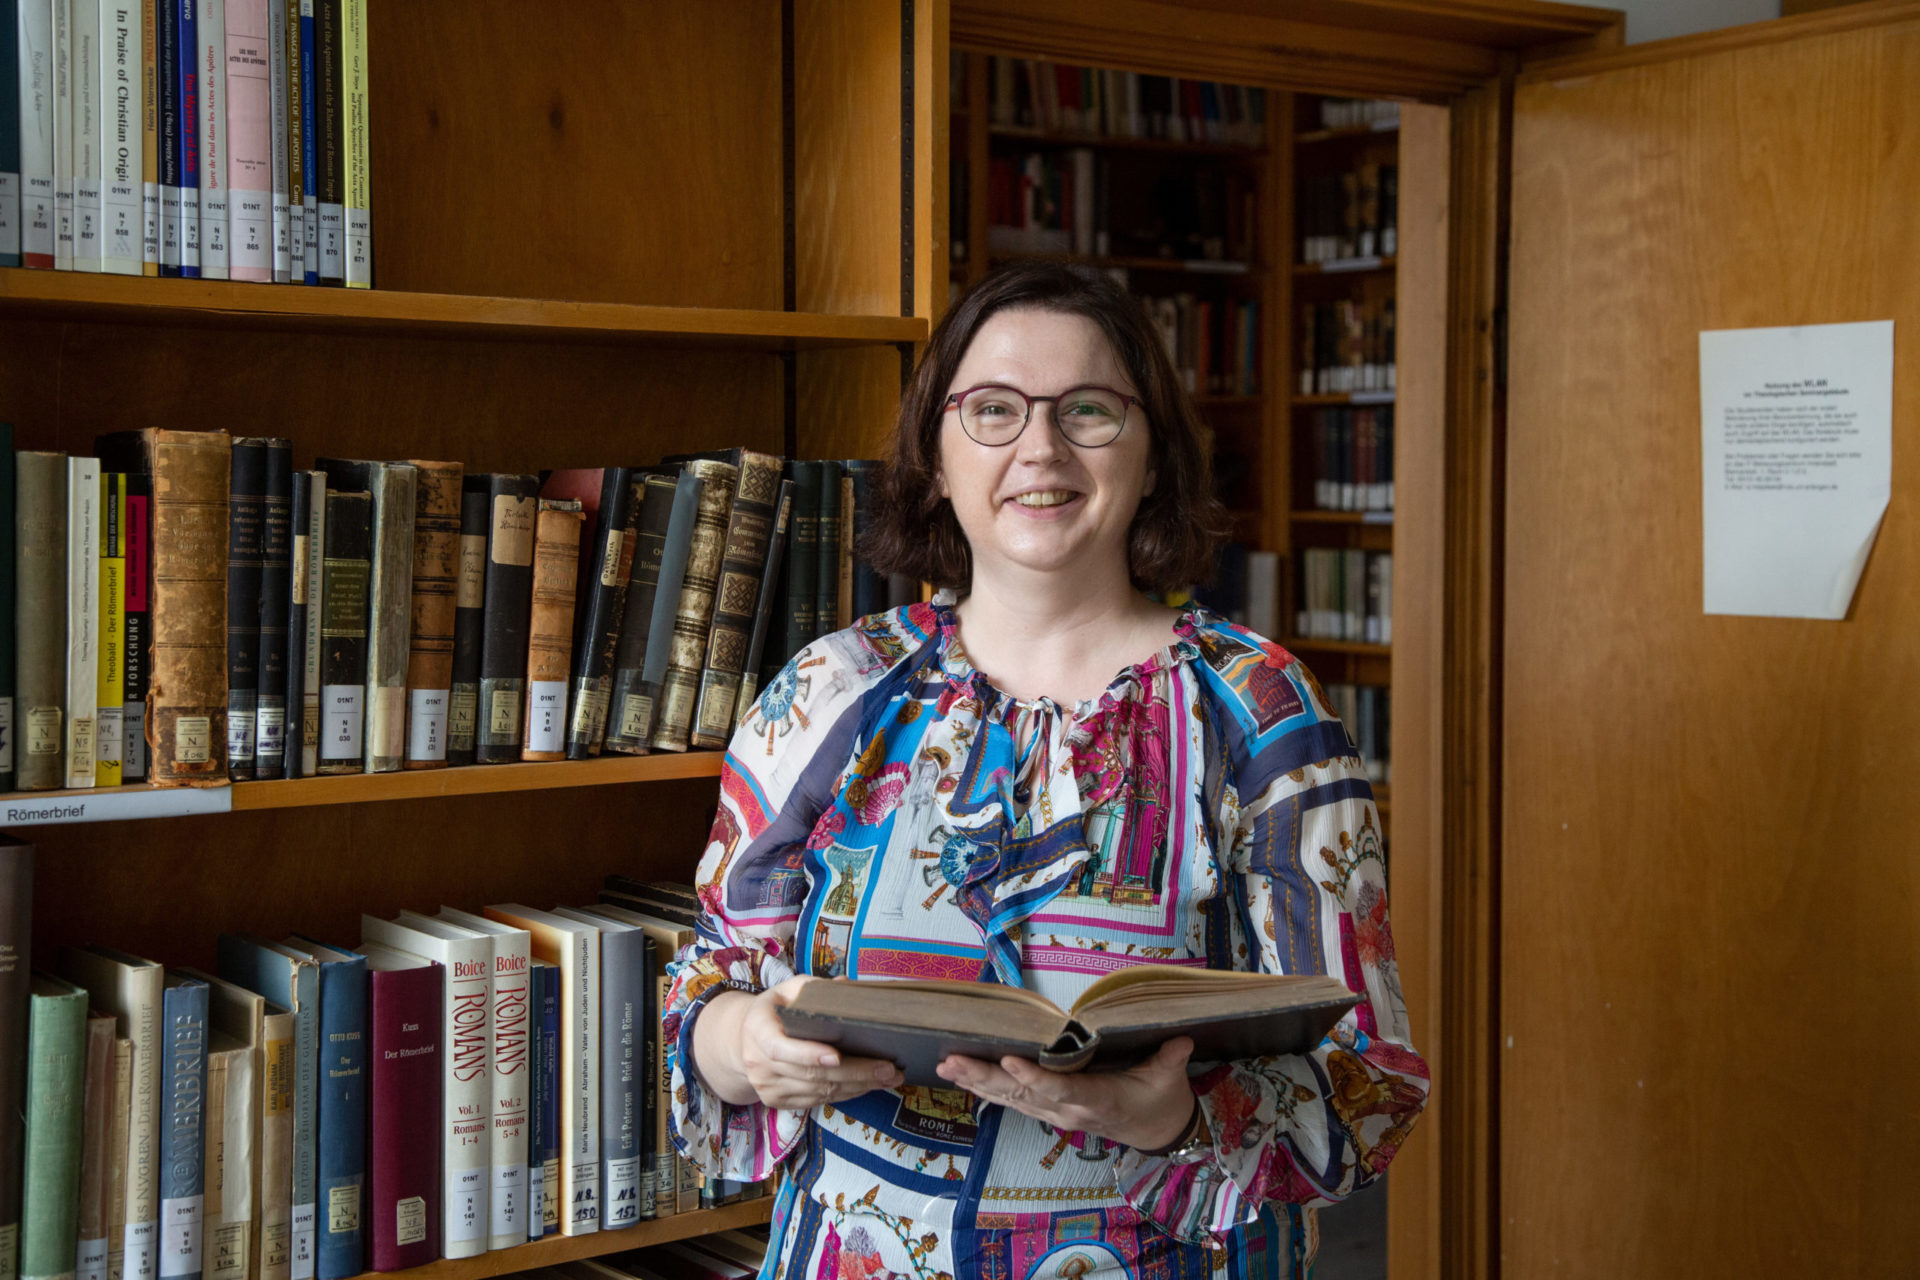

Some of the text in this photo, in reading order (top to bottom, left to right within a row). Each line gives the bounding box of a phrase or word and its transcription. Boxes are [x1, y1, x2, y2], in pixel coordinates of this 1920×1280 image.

[117, 9, 128, 23] In
[323, 3, 332, 21] Acts
[323, 22, 332, 30] of
[291, 23, 299, 57] PASSAGES
[324, 31, 332, 43] the
[117, 27, 129, 65] Praise
[207, 45, 216, 74] Apôtres
[291, 59, 299, 67] IN
[324, 46, 333, 76] Apostles
[117, 69, 130, 83] of
[183, 0, 197, 173] ervo The Mystery of Acts
[325, 94, 333, 107] the
[117, 86, 129, 142] Christian
[292, 105, 299, 115] OF
[326, 108, 334, 139] Rhetoric
[208, 142, 216, 158] Paul
[326, 141, 334, 149] of
[292, 136, 300, 173] APOSTLES
[208, 159, 216, 168] de
[326, 151, 334, 176] Roman
[31, 179, 51, 187] 01NT
[208, 169, 217, 189] igure
[79, 190, 98, 198] 01NT
[112, 187, 132, 195] 01NT
[290, 184, 300, 205] Camp
[308, 510, 320, 673] GRUNDMANN DER RÖMERBRIEF
[106, 566, 118, 683] Theobald Der Römerbrief
[128, 617, 139, 687] FORSCHUNG
[1214, 651, 1234, 670] ROME
[337, 696, 354, 704] 01NT
[426, 698, 442, 706] 01NT
[7, 804, 85, 823] Römerbrief
[495, 954, 526, 972] Boice
[581, 938, 590, 977] Nichtjuden
[454, 959, 486, 978] Boice
[581, 979, 589, 993] und
[581, 994, 589, 1016] Juden
[402, 1023, 419, 1032] Kuss
[453, 984, 488, 1083] ROMANS
[494, 979, 527, 1076] ROMANS
[330, 1032, 361, 1042] OTTO KUSS
[581, 1033, 589, 1051] Vater
[340, 1056, 351, 1064] Der
[384, 1044, 434, 1060] Der Römerbrief
[269, 1064, 277, 1090] PRÜMM
[329, 1068, 361, 1078] Römerbrief
[581, 1058, 589, 1091] Abraham
[621, 1002, 633, 1149] Erik Peterson Brief an die Römer
[301, 1006, 311, 1187] ETZOLD GEHORSAM DES GLAUBENS
[500, 1098, 521, 1109] Vol. 2
[138, 1096, 152, 1124] DER
[458, 1104, 480, 1116] Vol. 1
[581, 1097, 589, 1132] Neubrand
[453, 1122, 486, 1136] Romans
[496, 1115, 525, 1128] Romans
[918, 1117, 954, 1134] ROME
[462, 1135, 480, 1146] 1-4
[503, 1128, 520, 1139] 5-8
[581, 1133, 589, 1154] Maria
[463, 1175, 479, 1183] 01NT
[617, 1188, 628, 1201] N
[177, 1206, 196, 1216] 01NT
[295, 1214, 312, 1224] 01NT
[576, 1207, 596, 1219] 150
[616, 1206, 636, 1219] 152
[134, 1226, 154, 1235] 01NT
[84, 1255, 104, 1264] 01NT
